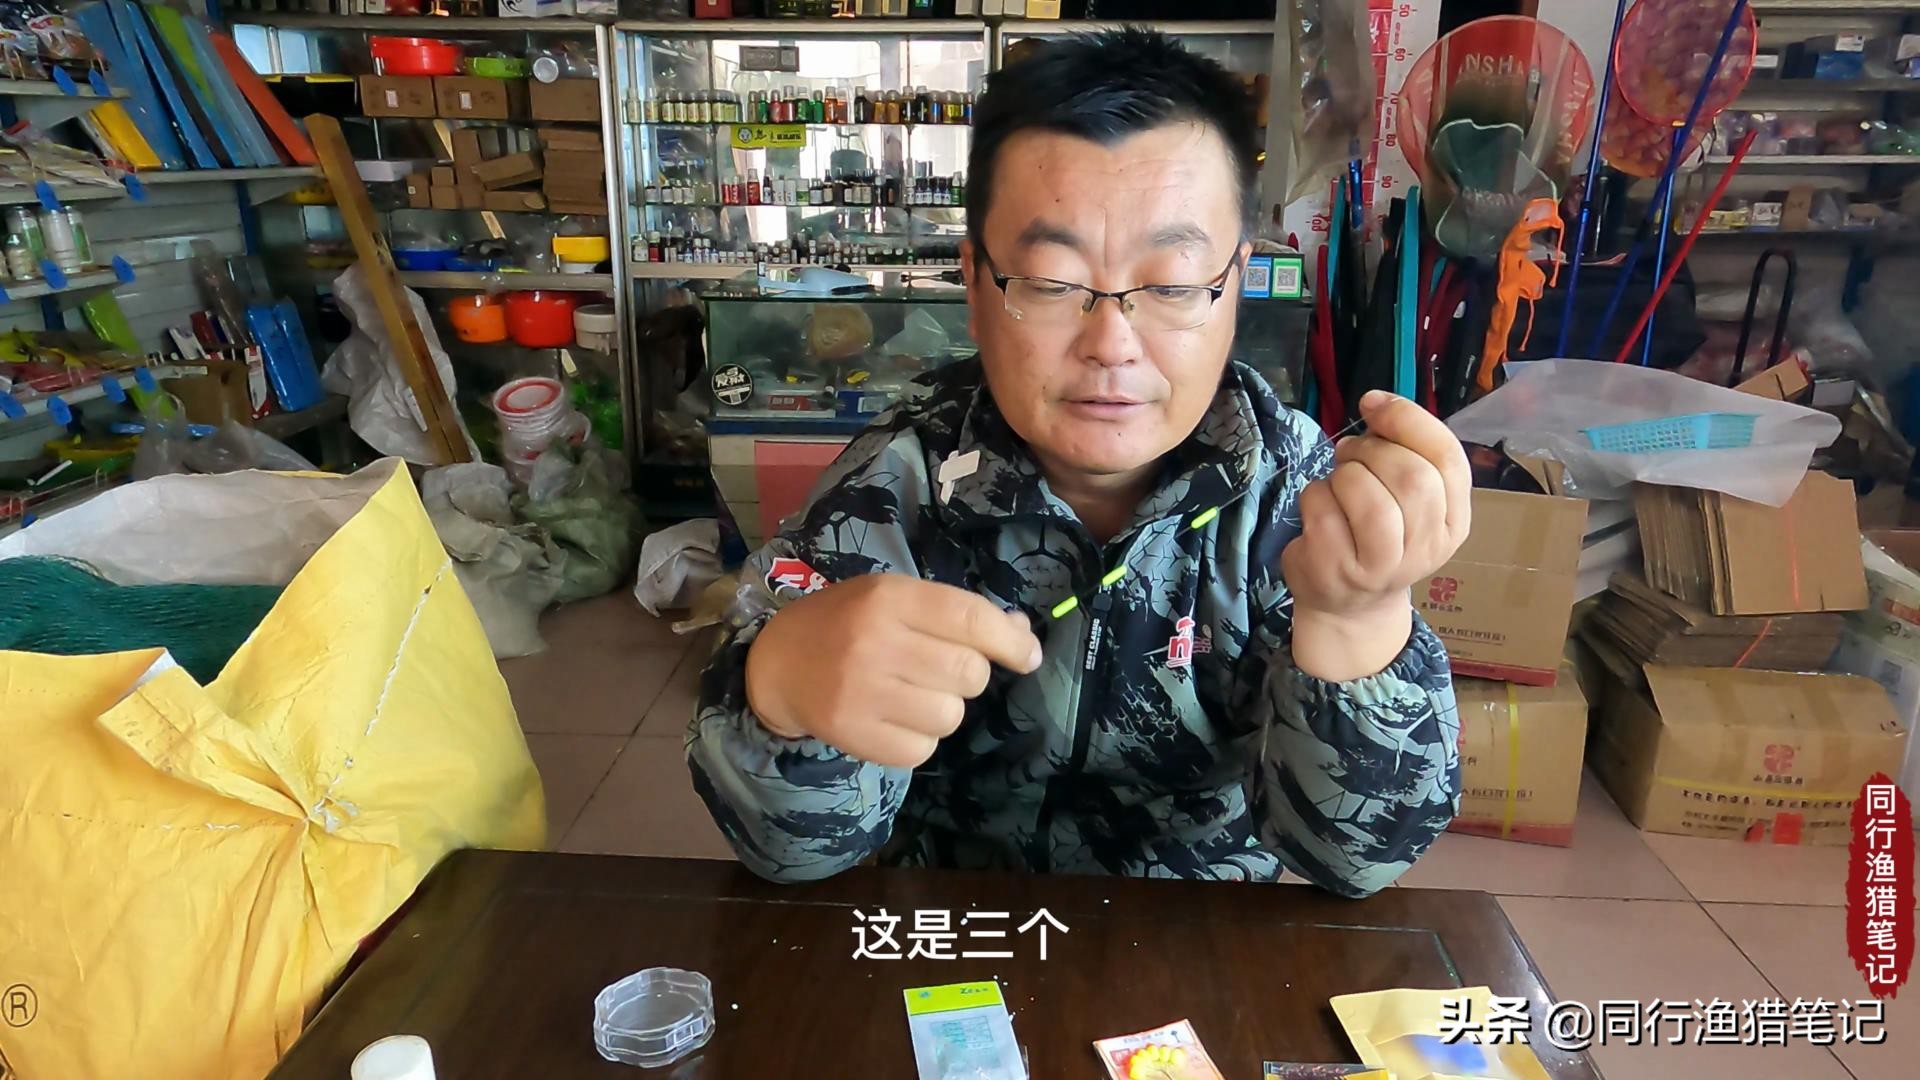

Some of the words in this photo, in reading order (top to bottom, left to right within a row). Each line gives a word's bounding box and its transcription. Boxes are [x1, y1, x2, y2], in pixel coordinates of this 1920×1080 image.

[1399, 4, 1410, 17] 50
[1394, 48, 1406, 61] 60
[1386, 134, 1397, 147] 80
[1381, 175, 1392, 188] 90
